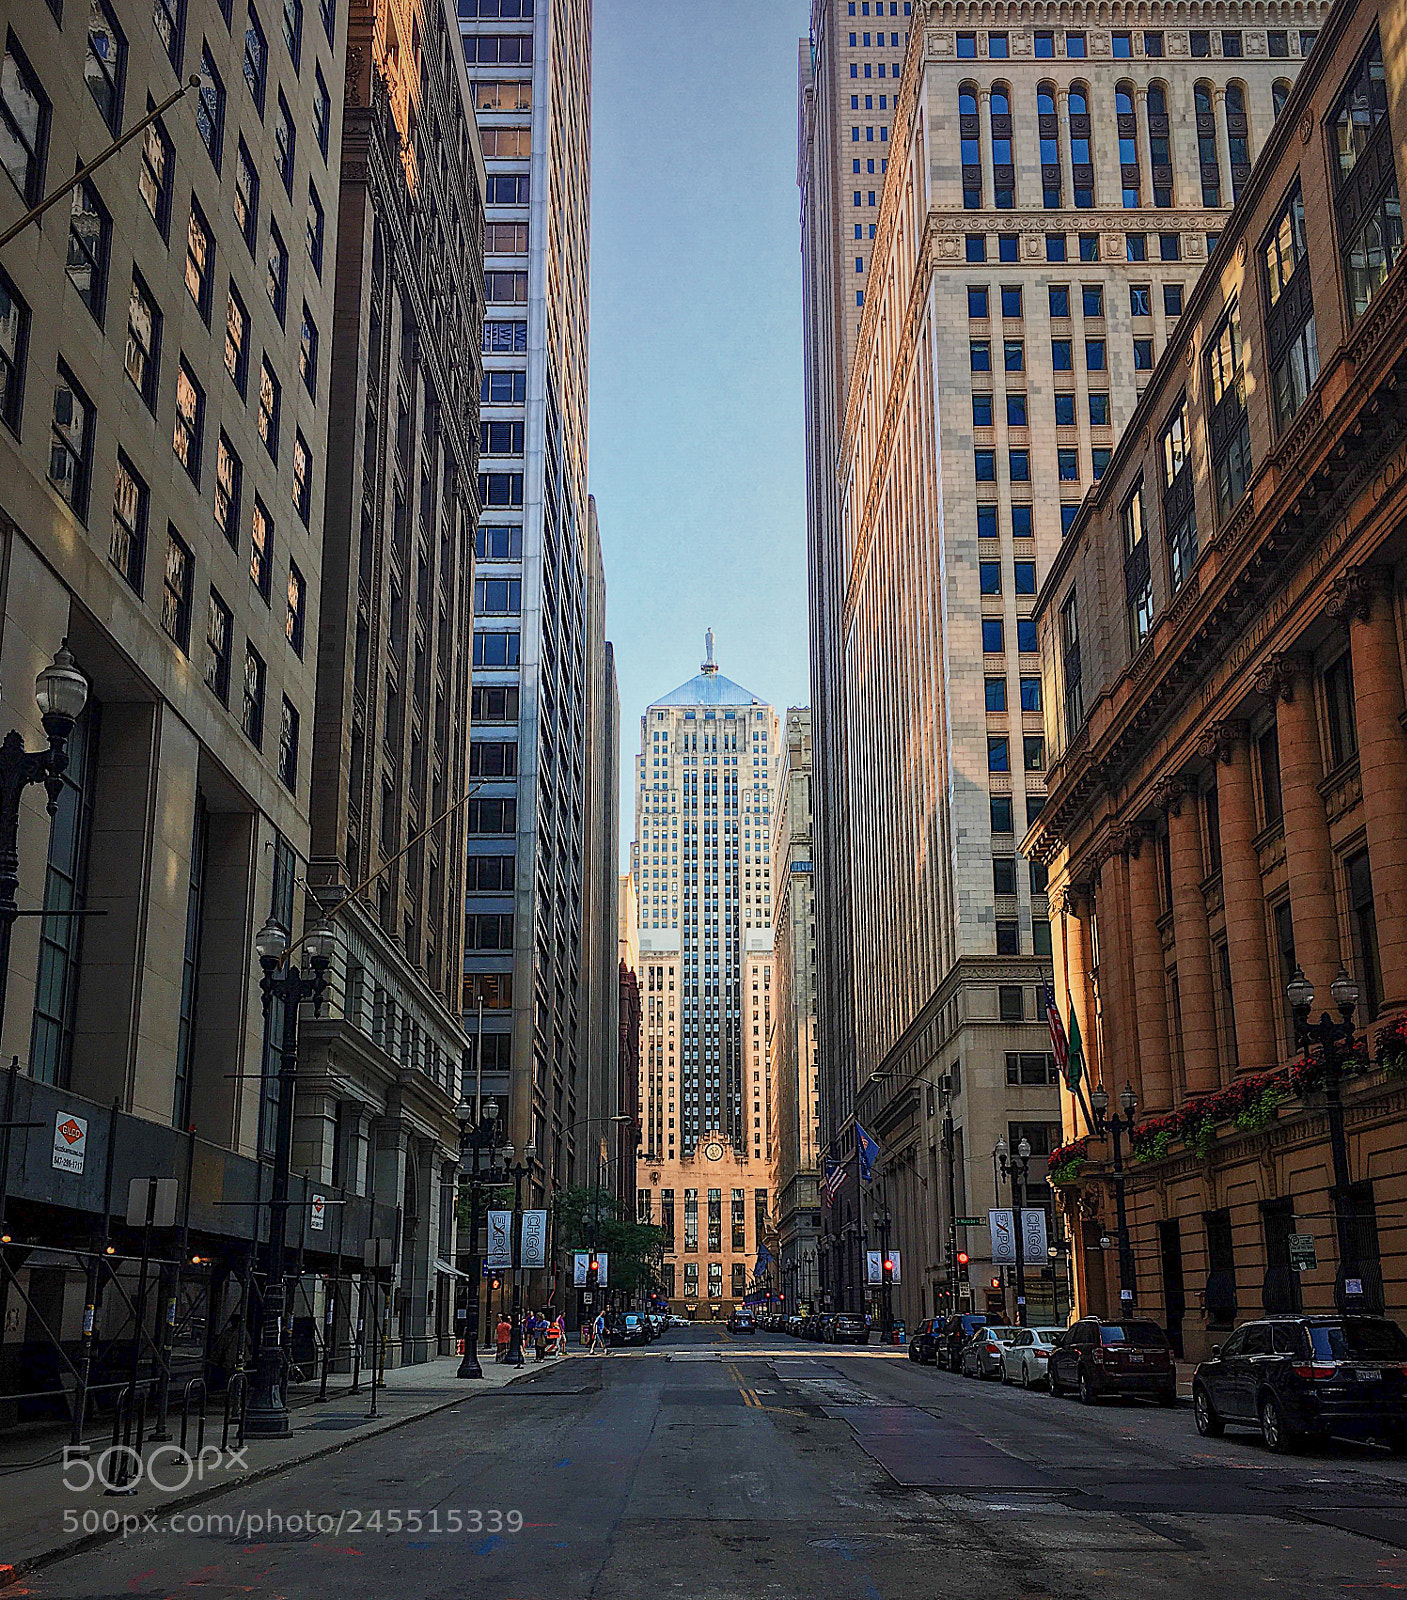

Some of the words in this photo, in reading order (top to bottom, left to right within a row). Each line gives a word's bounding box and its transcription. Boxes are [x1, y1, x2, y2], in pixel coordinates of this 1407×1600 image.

[492, 1214, 506, 1259] EXPO
[526, 1214, 541, 1260] CHGO
[994, 1212, 1010, 1256] EXPO
[1026, 1212, 1042, 1256] CHGO
